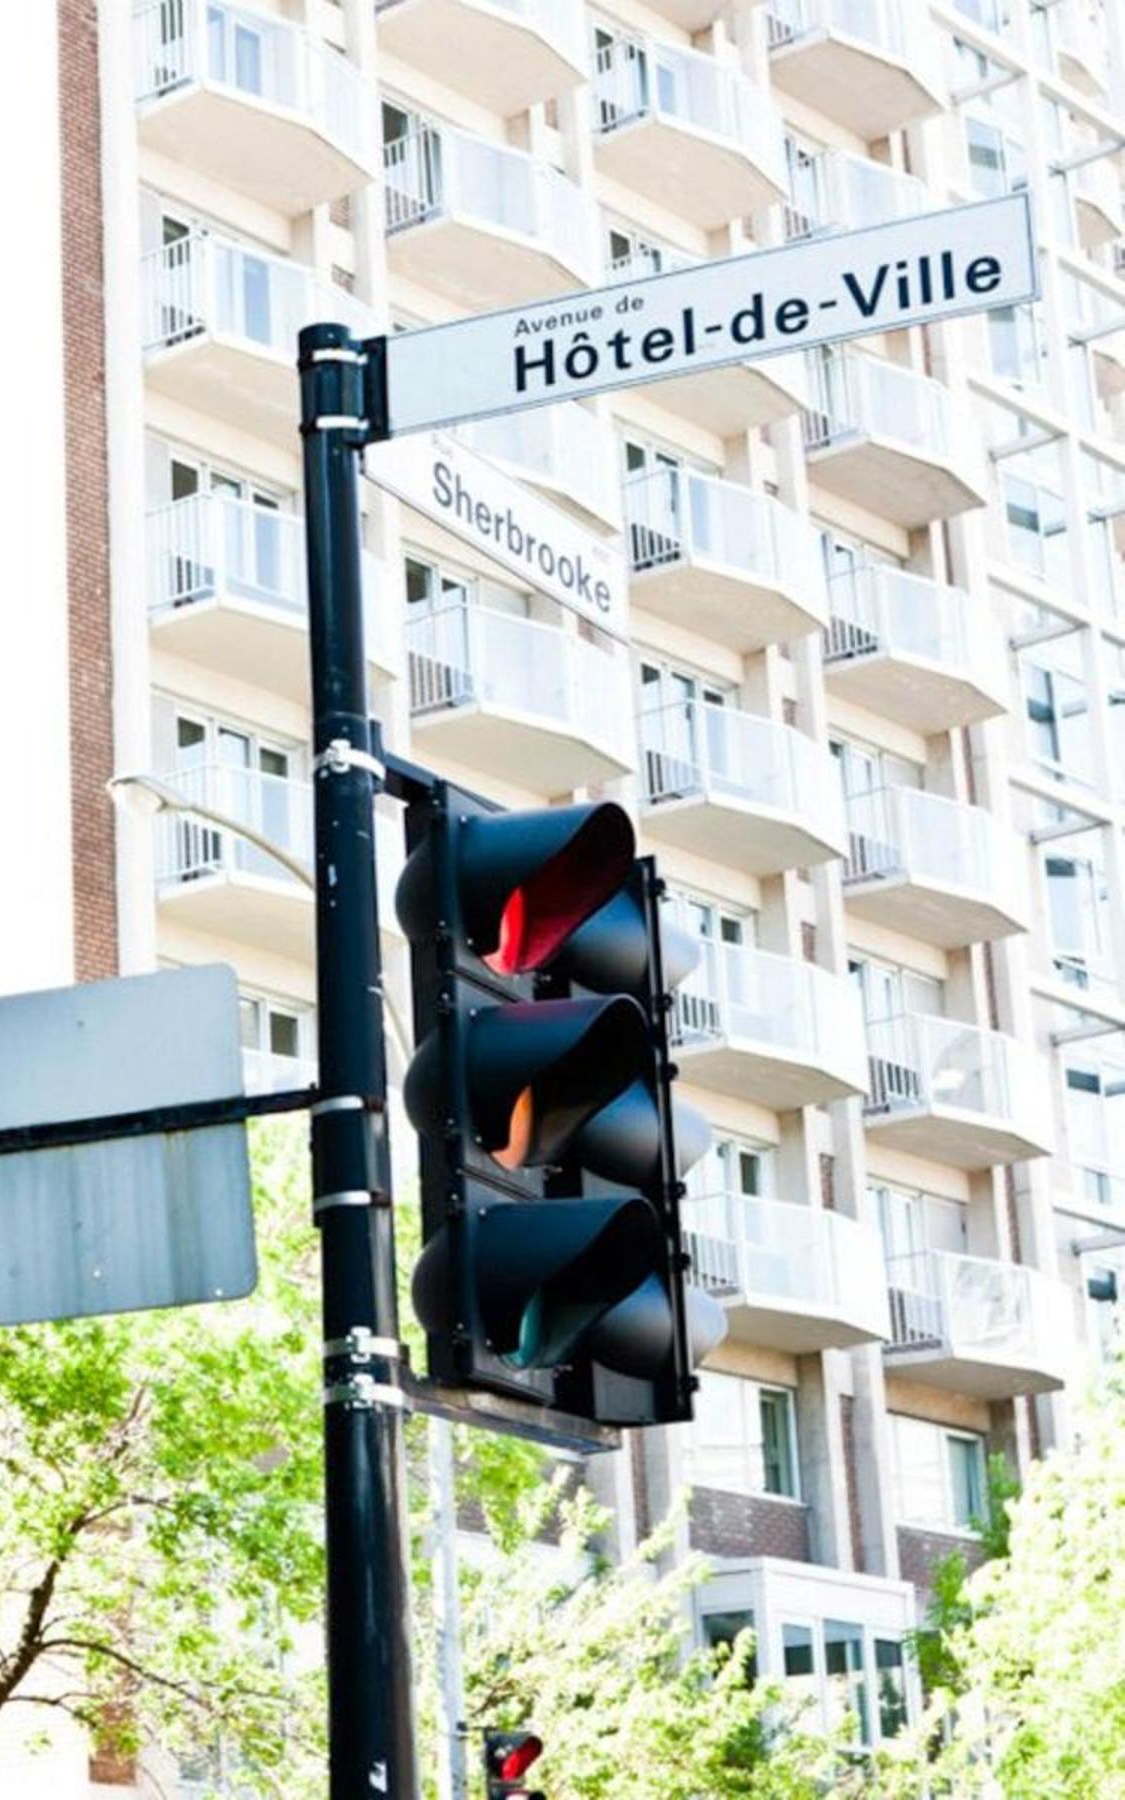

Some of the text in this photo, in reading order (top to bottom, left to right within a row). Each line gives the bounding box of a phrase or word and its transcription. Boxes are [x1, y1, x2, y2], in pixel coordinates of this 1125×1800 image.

[514, 294, 644, 338] Avenue de
[514, 250, 1002, 393] Hôtel-de-Ville
[432, 462, 612, 614] Sherbrooke
